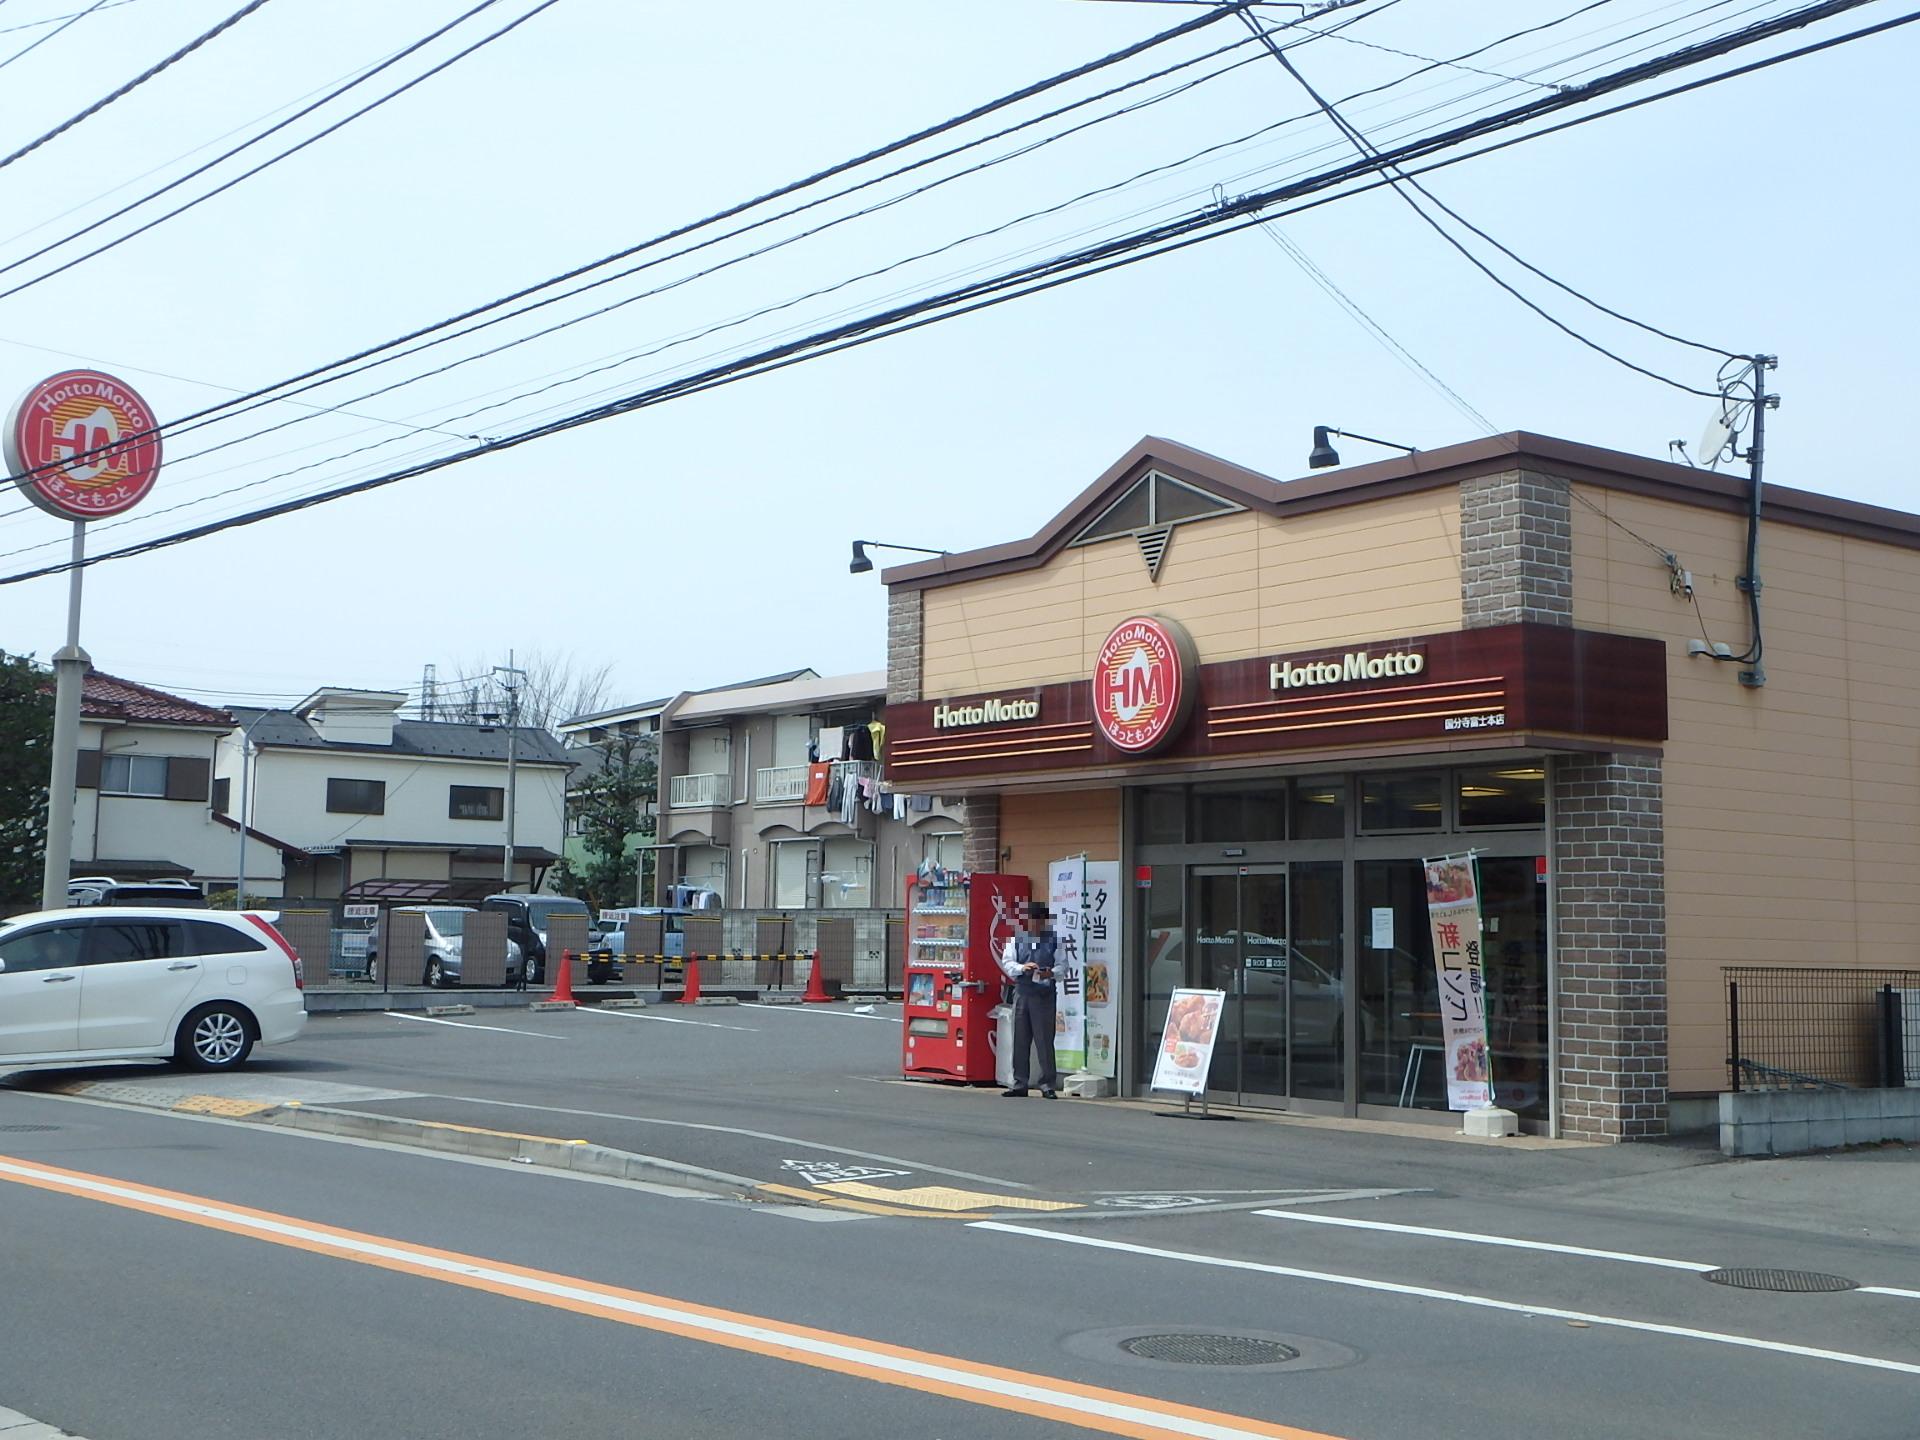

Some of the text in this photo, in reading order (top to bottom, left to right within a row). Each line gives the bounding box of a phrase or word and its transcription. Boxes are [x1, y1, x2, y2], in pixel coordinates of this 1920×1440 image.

[46, 474, 133, 507] ほっともっと
[1108, 716, 1161, 744] ほっともっと
